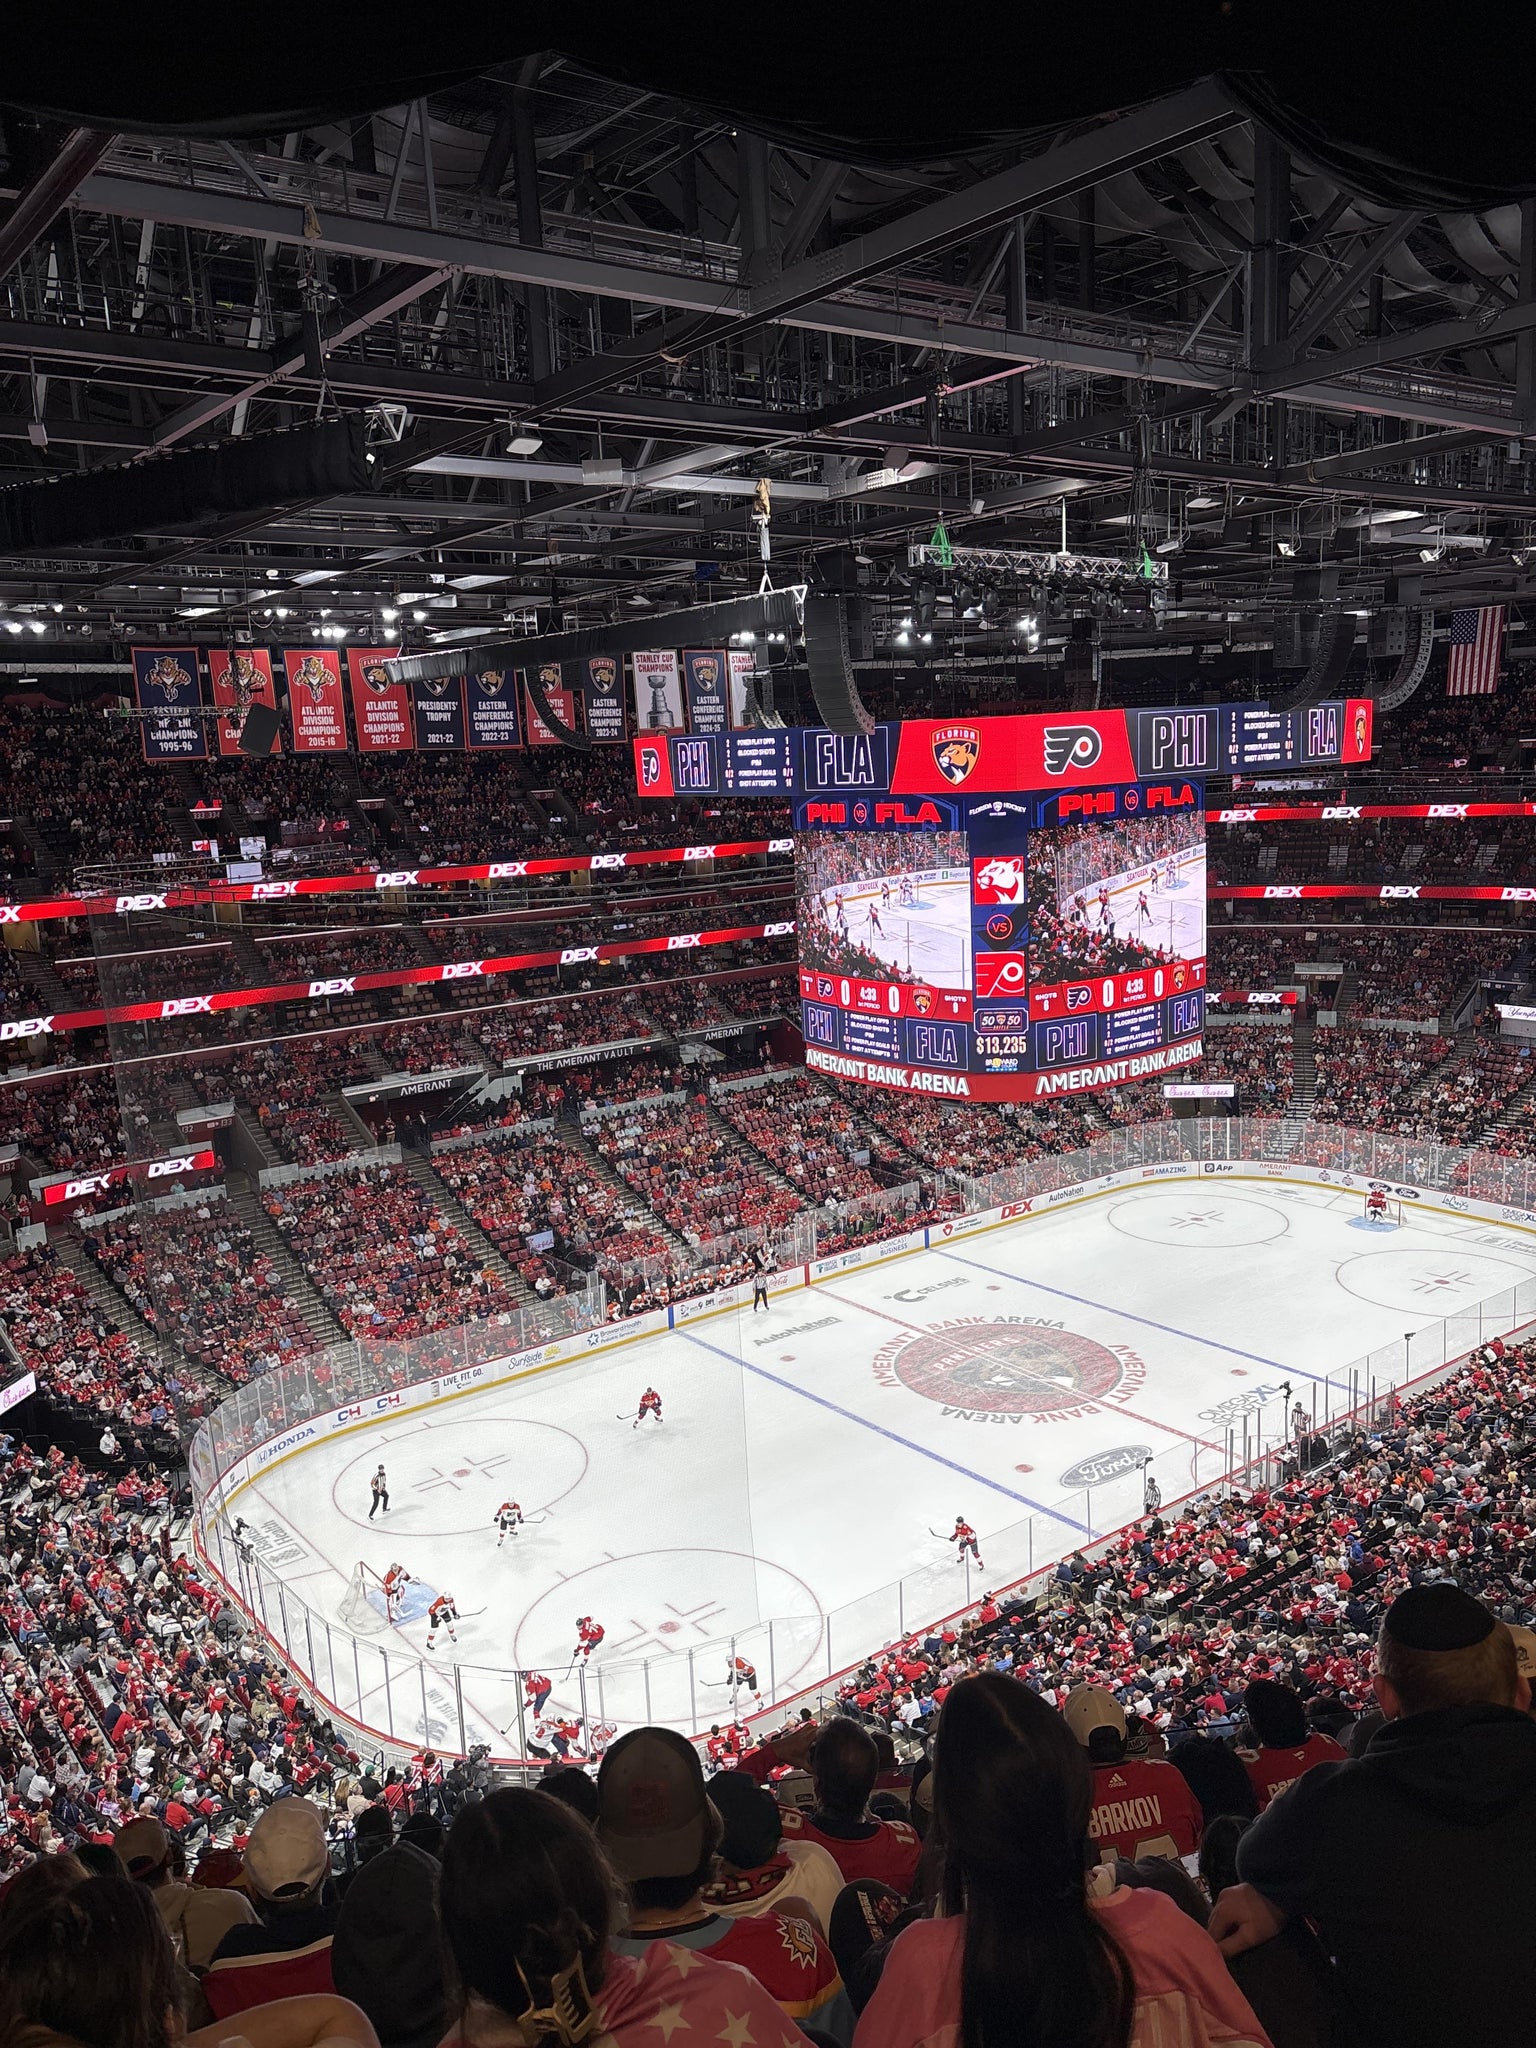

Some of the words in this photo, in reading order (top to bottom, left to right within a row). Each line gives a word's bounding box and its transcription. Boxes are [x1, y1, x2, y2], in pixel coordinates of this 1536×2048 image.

[636, 654, 660, 664] STANLEY
[662, 654, 674, 663] CUP
[638, 663, 674, 672] CHAMPIONS
[366, 701, 398, 711] ATLANTIC
[417, 701, 458, 711] PRESIDENTS'
[478, 701, 507, 710] EASTERN
[592, 698, 617, 708] EASTERN
[696, 696, 720, 705] EASTERN
[301, 706, 334, 716] ATLANTIC
[472, 711, 514, 720] CONFERENCE
[588, 708, 622, 717] CONFERENCE
[692, 704, 724, 714] CONFERENCE
[303, 716, 334, 726] DIVISION
[367, 712, 399, 722] DIVISION
[426, 712, 452, 722] TROPHY
[590, 718, 622, 727] CHAMPIONS
[694, 714, 724, 724] CHAMPIONS
[299, 726, 340, 736] CHAMPIONS
[364, 722, 405, 733] CHAMPIONS
[474, 721, 514, 731] CHAMPIONS
[596, 728, 618, 737] 2023-24
[1308, 708, 1337, 756] FLA
[308, 736, 336, 747] 2015-16
[371, 734, 400, 744] 2021-22
[428, 734, 454, 743] 2021-22
[482, 732, 509, 742] 2022-23
[935, 730, 976, 741] FLORIDA
[1152, 715, 1206, 770] PHI
[159, 741, 192, 752] 1995-96
[677, 742, 711, 787] PHI
[816, 736, 874, 784] FLA
[968, 801, 993, 816] FLORIDA
[1002, 801, 1027, 814] HOCKEY
[1058, 792, 1115, 817] PHI
[1146, 785, 1194, 808] FLA
[806, 803, 846, 823] PHI
[875, 803, 942, 823] FLA
[1218, 809, 1258, 822] DEX
[1322, 806, 1364, 820] DEX
[1428, 804, 1470, 818] DEX
[684, 844, 716, 861] DEX
[590, 853, 628, 870] DEX
[489, 862, 528, 878] DEX
[376, 870, 420, 888] DEX
[251, 880, 300, 899] DEX
[1264, 886, 1304, 898] DEX
[1380, 886, 1422, 898] DEX
[115, 894, 168, 913] DEX
[764, 920, 796, 936] DEX
[992, 922, 1008, 932] VS
[668, 934, 702, 949] DEX
[560, 946, 600, 965] DEX
[442, 960, 485, 980] DEX
[308, 977, 356, 998] DEX
[1102, 979, 1114, 1008] 0
[1126, 978, 1144, 994] 4:33
[1154, 969, 1164, 997] 0
[841, 980, 850, 1006] 0
[860, 986, 877, 1002] 4:33
[888, 986, 900, 1013] 0
[945, 995, 967, 1003] SHOTS
[1035, 992, 1057, 1000] SHOTS
[1247, 993, 1282, 1003] DEX
[161, 996, 214, 1018] DEX
[982, 1016, 995, 1026] 50
[1007, 1015, 1020, 1025] 50
[1174, 997, 1199, 1034] FLA
[0, 1016, 54, 1040] DEX
[808, 1007, 832, 1042] PHI
[704, 1027, 744, 1040] AMERANT
[916, 1026, 958, 1063] FLA
[976, 1036, 1027, 1055] $13,235
[1046, 1022, 1088, 1062] PHI
[537, 1061, 552, 1072] THE
[555, 1054, 600, 1069] AMERANT
[603, 1046, 634, 1061] VAULT
[806, 1050, 866, 1079] AMERANT
[867, 1062, 908, 1088] BANK
[910, 1071, 970, 1096] ARENA
[1034, 1060, 1129, 1095] AMERANT
[1130, 1050, 1167, 1078] BANK
[1166, 1040, 1204, 1066] ARENA
[400, 1079, 453, 1096] AMERANT
[220, 1118, 232, 1128] 133
[2, 1162, 16, 1172] 132
[148, 1156, 196, 1178] DEX
[1155, 1166, 1187, 1175] AMAZING
[1258, 1163, 1292, 1171] AMERANT
[64, 1173, 111, 1200] DEX
[1049, 1186, 1084, 1202] AutoNation
[1372, 1183, 1389, 1192] Ford
[1398, 1189, 1416, 1198] Ford
[1000, 1200, 1034, 1220] DEX
[1502, 1208, 1525, 1217] OMEGA
[1502, 1213, 1524, 1222] SPORT
[880, 1237, 907, 1250] COMCAST
[880, 1242, 908, 1256] BUSINESS
[916, 1277, 970, 1295] CELSIUS
[752, 1314, 839, 1346] AutoNation
[872, 1331, 916, 1388] AMERANT
[926, 1315, 988, 1332] BANK
[992, 1315, 1066, 1330] ARENA
[933, 1336, 1021, 1372] PANTHERS
[508, 1352, 542, 1370] Surfside
[442, 1376, 459, 1387] LIVE.
[460, 1372, 471, 1383] FIT.
[472, 1368, 484, 1378] GO.
[1108, 1344, 1146, 1404] AMERANT
[376, 1394, 400, 1409] CH
[1198, 1393, 1253, 1420] OMEGA
[338, 1406, 361, 1422] CH
[940, 1406, 1023, 1424] ARENA
[1032, 1404, 1102, 1424] BANK
[1212, 1401, 1268, 1427] SPORT
[267, 1427, 316, 1457] HONDA
[1078, 1449, 1138, 1483] Ford
[248, 1526, 274, 1554] Baptis
[260, 1520, 294, 1546] Health
[1032, 1656, 1046, 1670] 93
[739, 1736, 746, 1750] 9
[1088, 1794, 1162, 1838] BARKOV
[892, 1821, 916, 1845] 19
